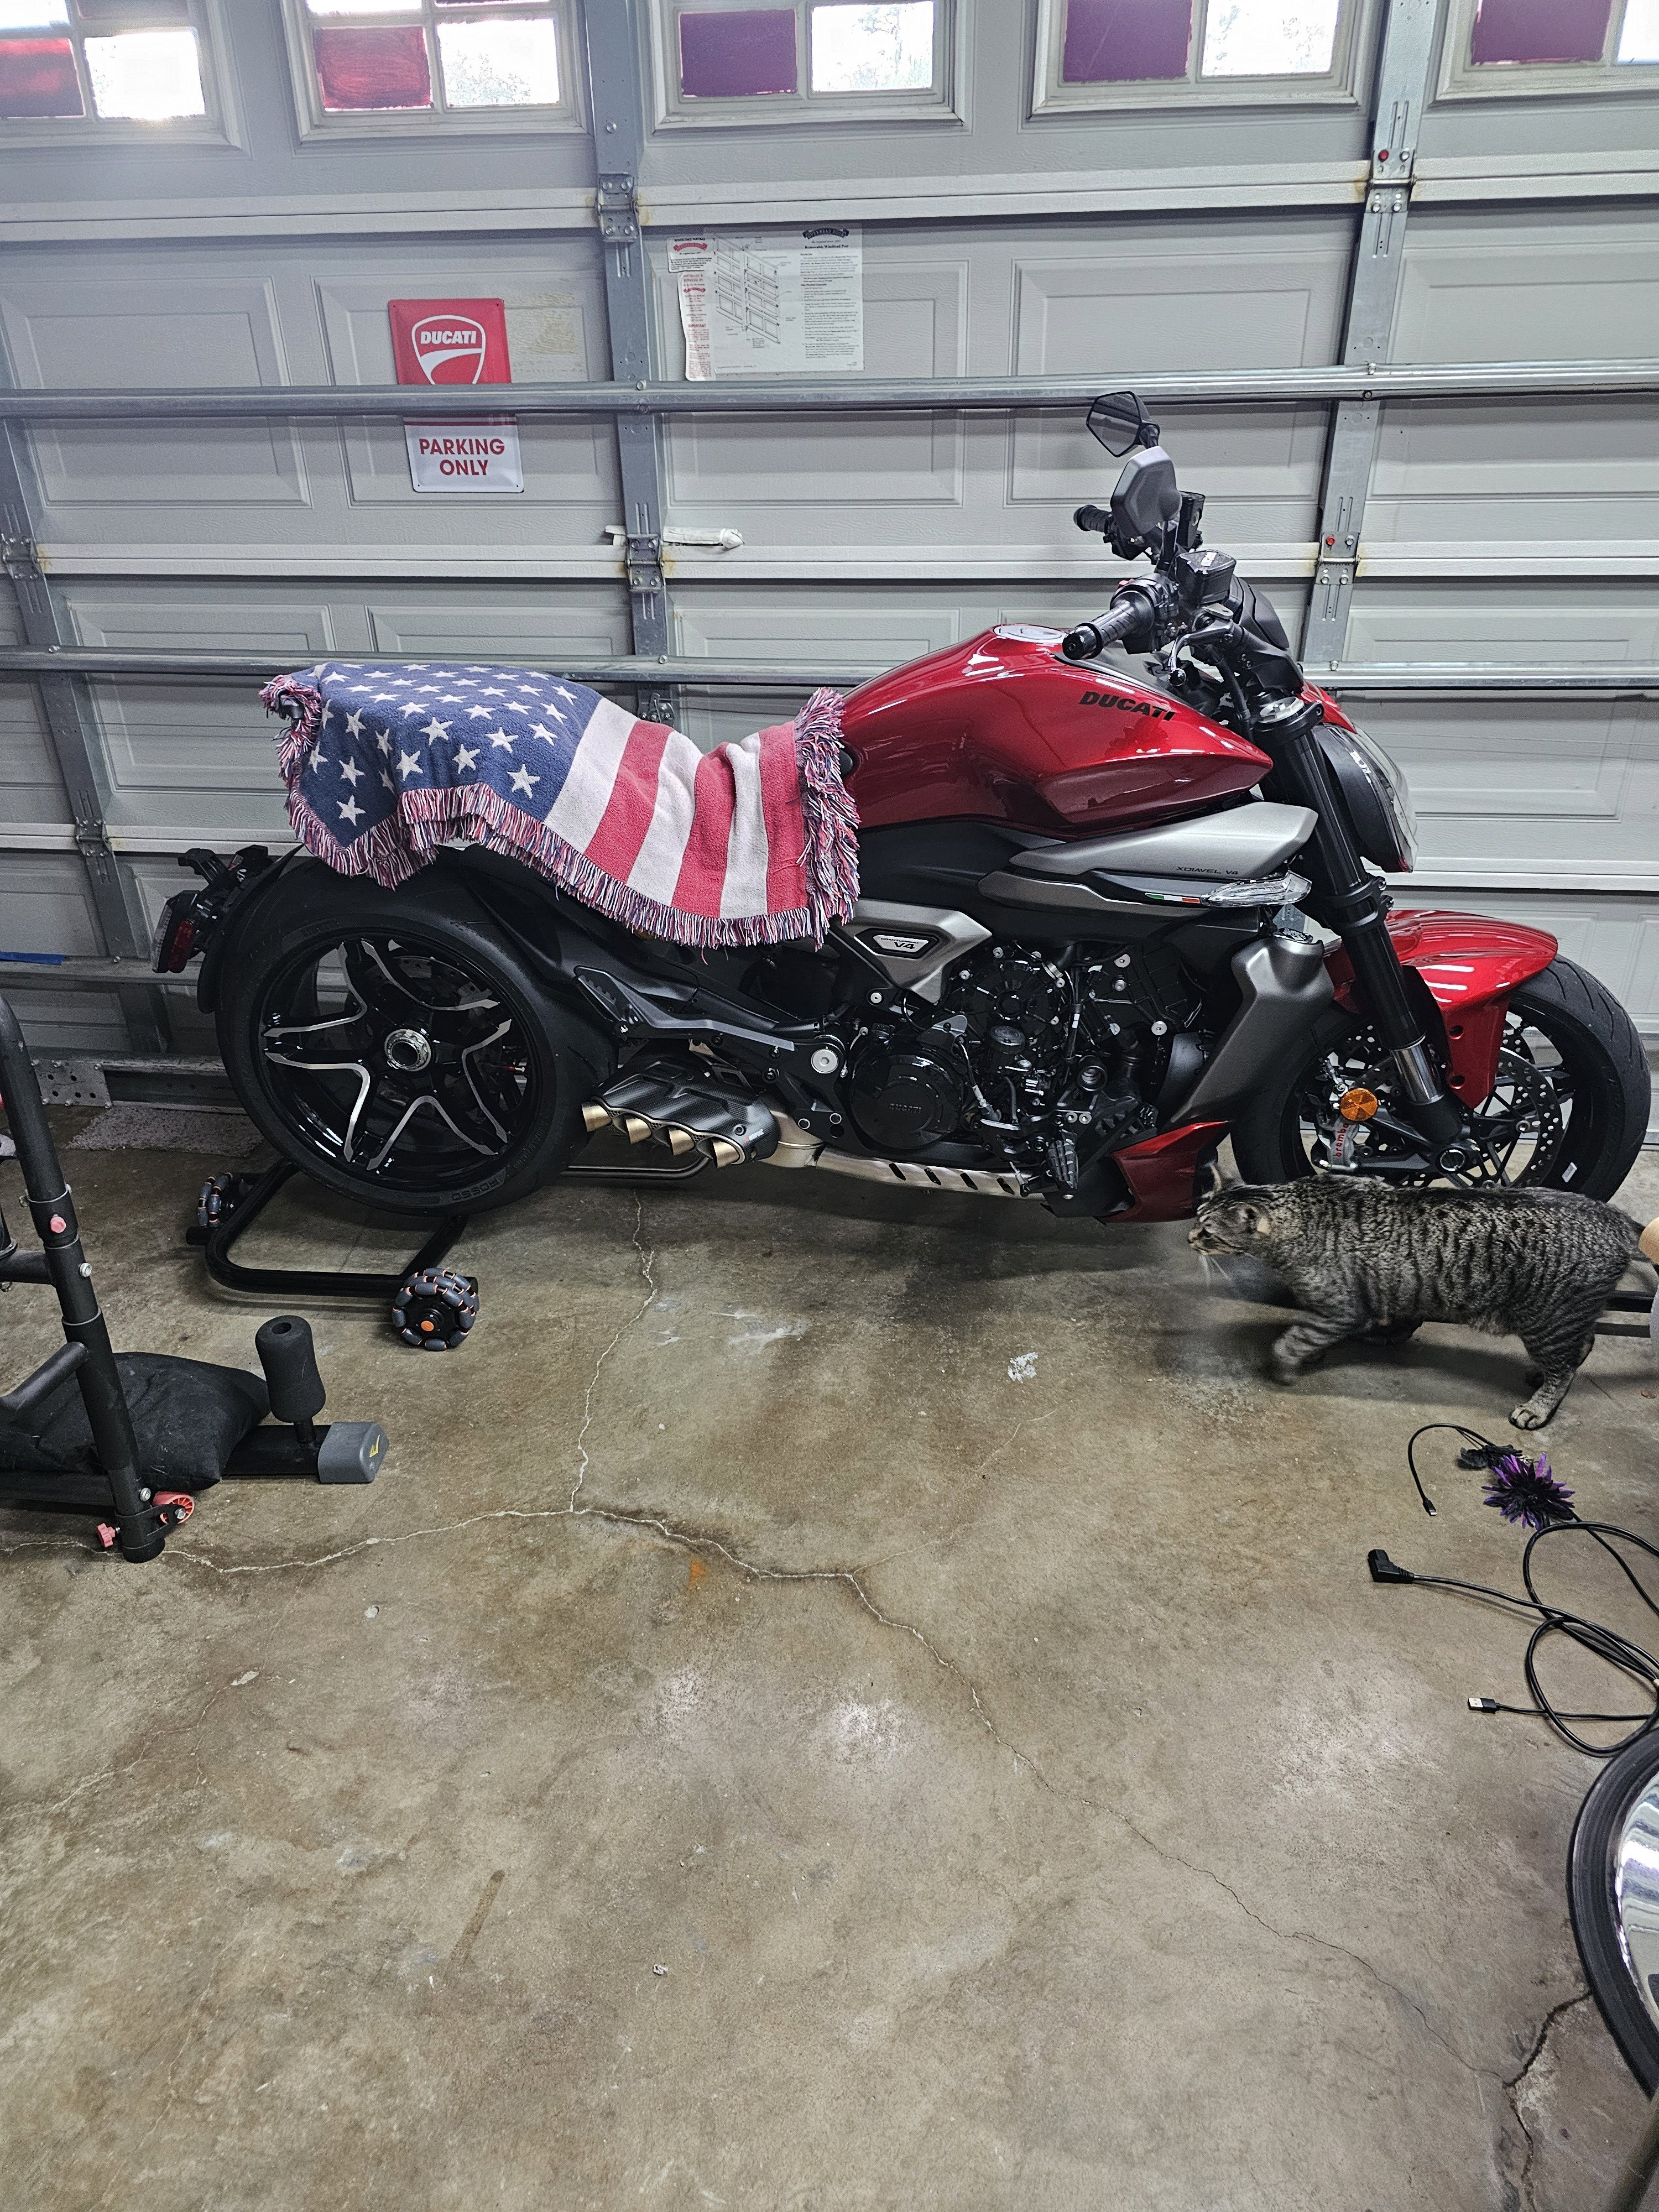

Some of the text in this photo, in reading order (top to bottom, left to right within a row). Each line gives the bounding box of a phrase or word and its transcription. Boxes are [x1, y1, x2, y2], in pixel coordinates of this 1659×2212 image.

[420, 330, 477, 345] DUCATI
[419, 438, 505, 455] PARKING
[439, 459, 489, 476] ONLY
[1078, 691, 1176, 721] DUCATI
[894, 941, 916, 950] V4
[1333, 1123, 1349, 1157] brembo
